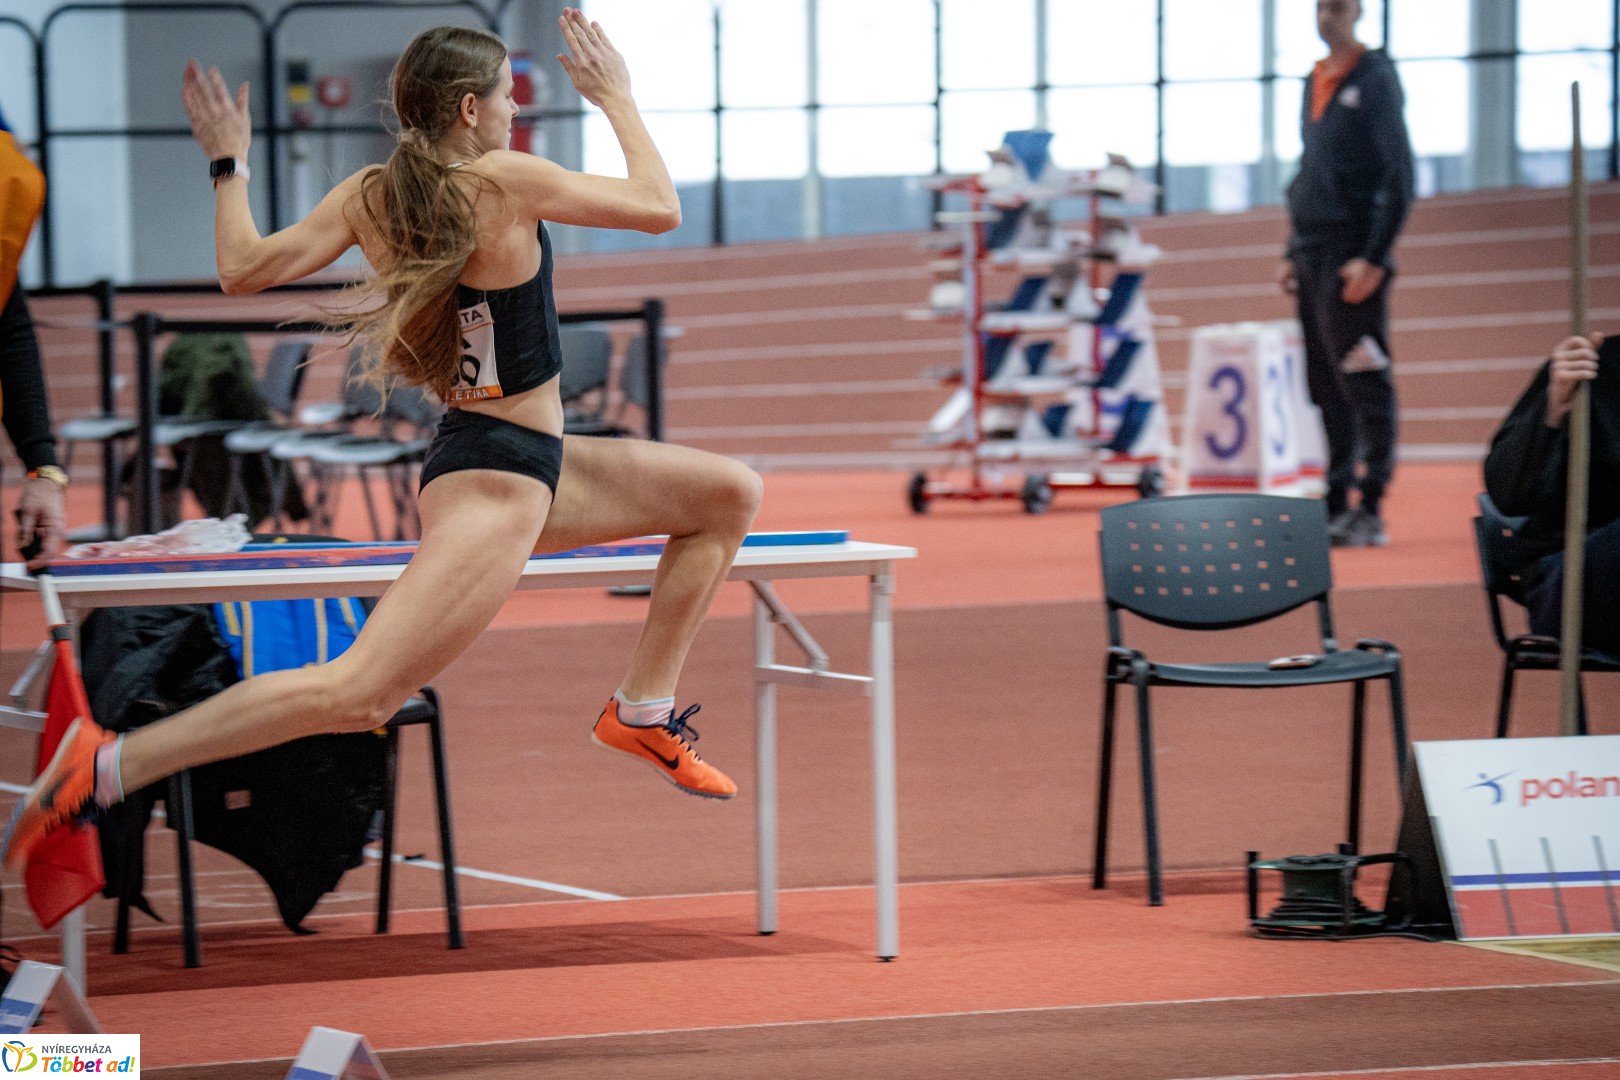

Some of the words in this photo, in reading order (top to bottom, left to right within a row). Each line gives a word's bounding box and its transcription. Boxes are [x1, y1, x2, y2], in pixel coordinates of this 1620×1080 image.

[460, 310, 484, 325] TA
[1206, 364, 1247, 460] 3
[1520, 770, 1620, 806] polan
